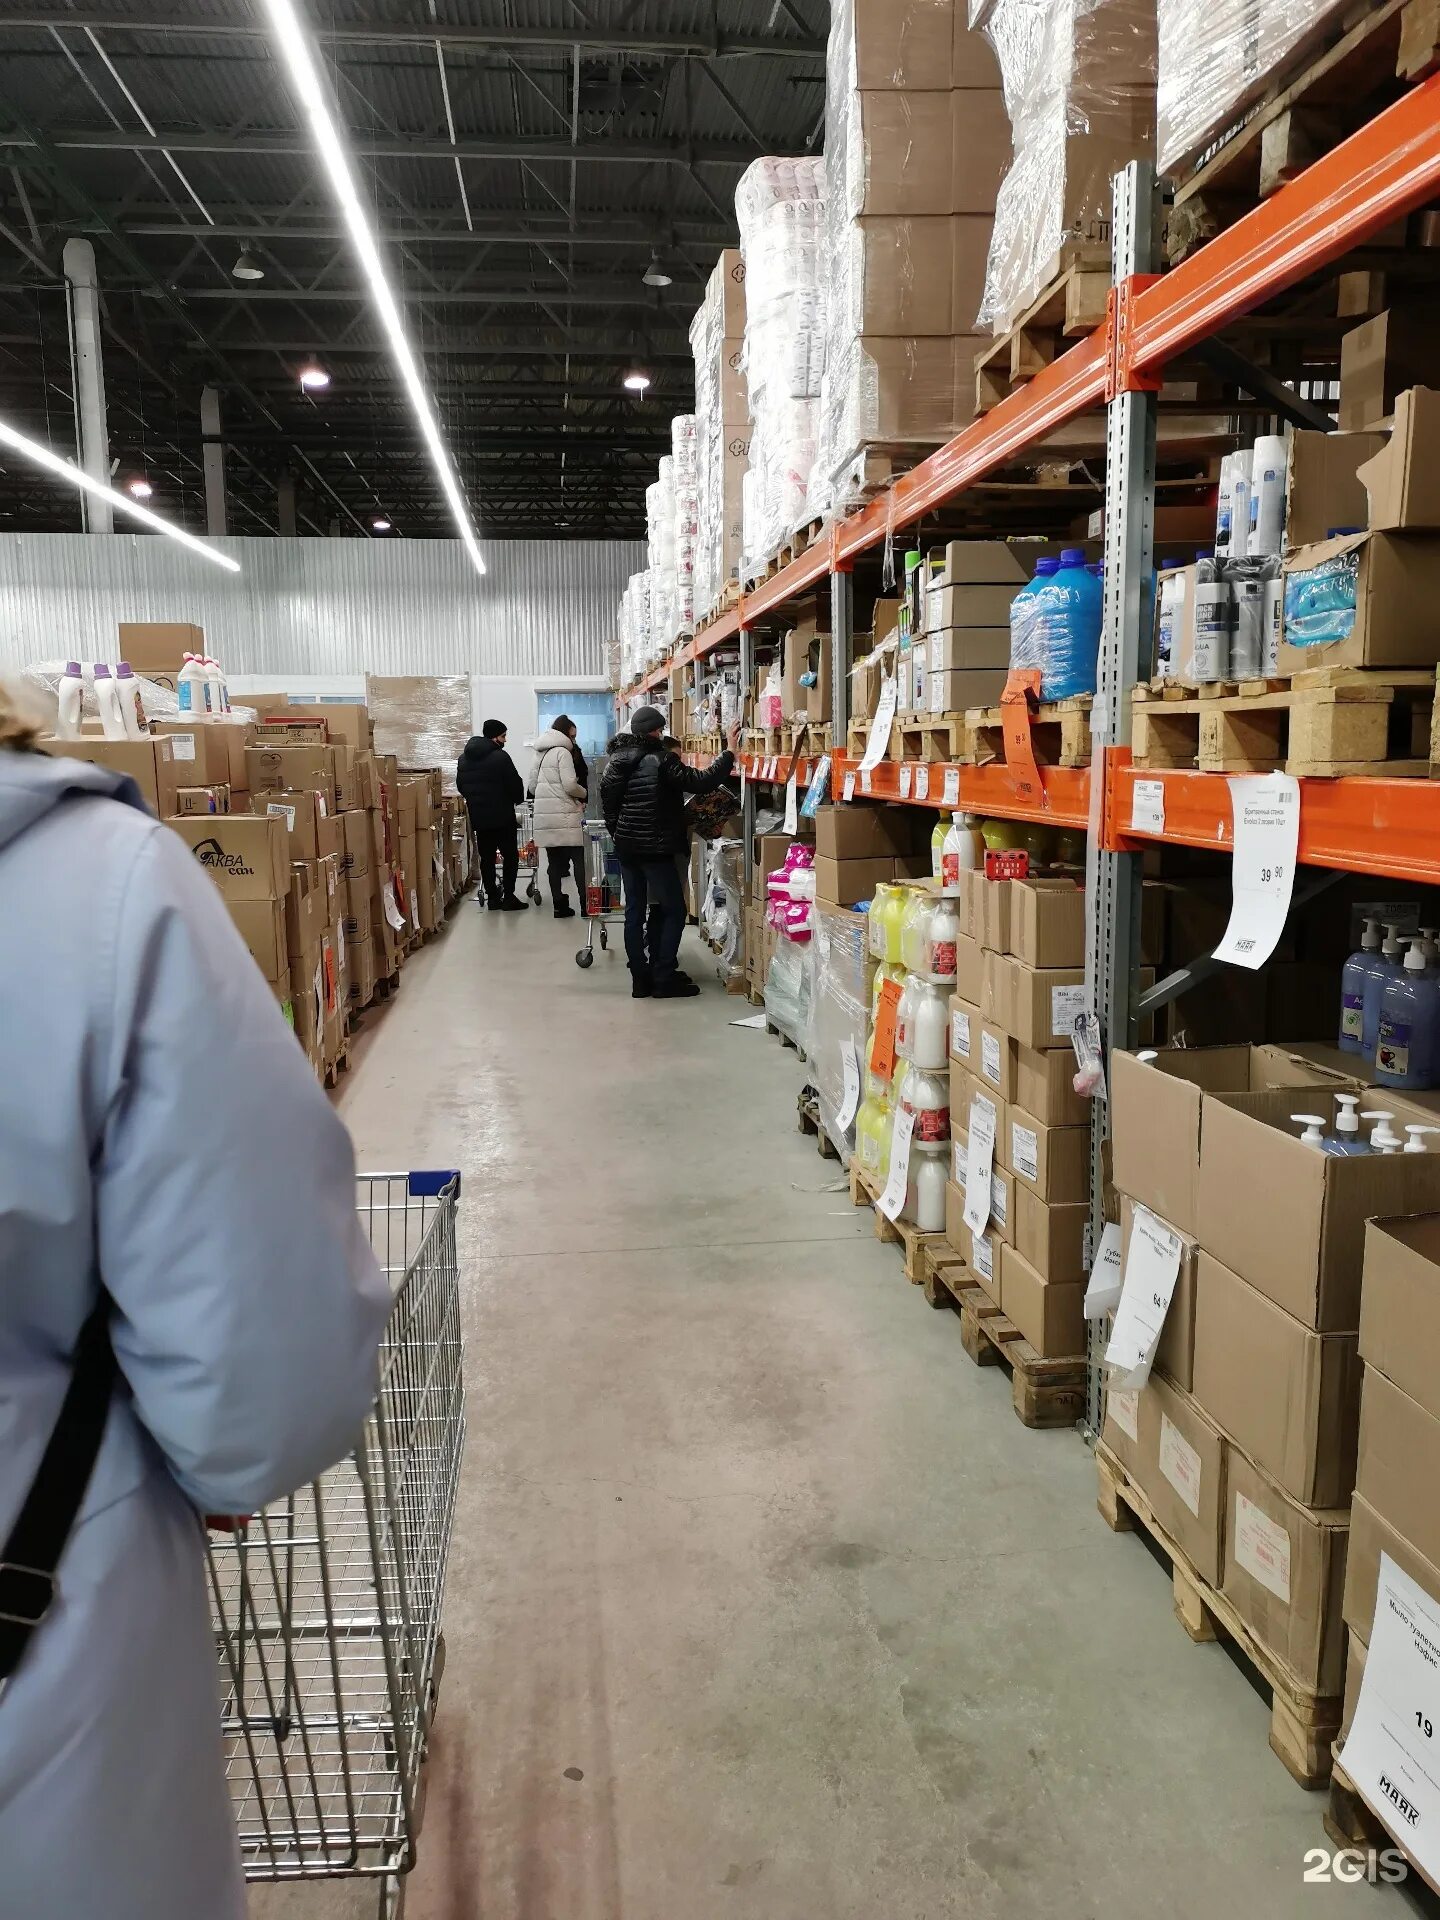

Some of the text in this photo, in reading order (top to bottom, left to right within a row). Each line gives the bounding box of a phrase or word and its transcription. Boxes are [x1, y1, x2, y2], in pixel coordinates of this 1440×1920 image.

[205, 854, 244, 867] АКВА
[1261, 866, 1284, 882] 39 90
[1153, 1293, 1161, 1308] 64
[1389, 1598, 1409, 1624] Мыло
[1414, 1639, 1438, 1669] Нэфис
[1415, 1711, 1433, 1738] 19
[1379, 1775, 1419, 1827] МАЯК
